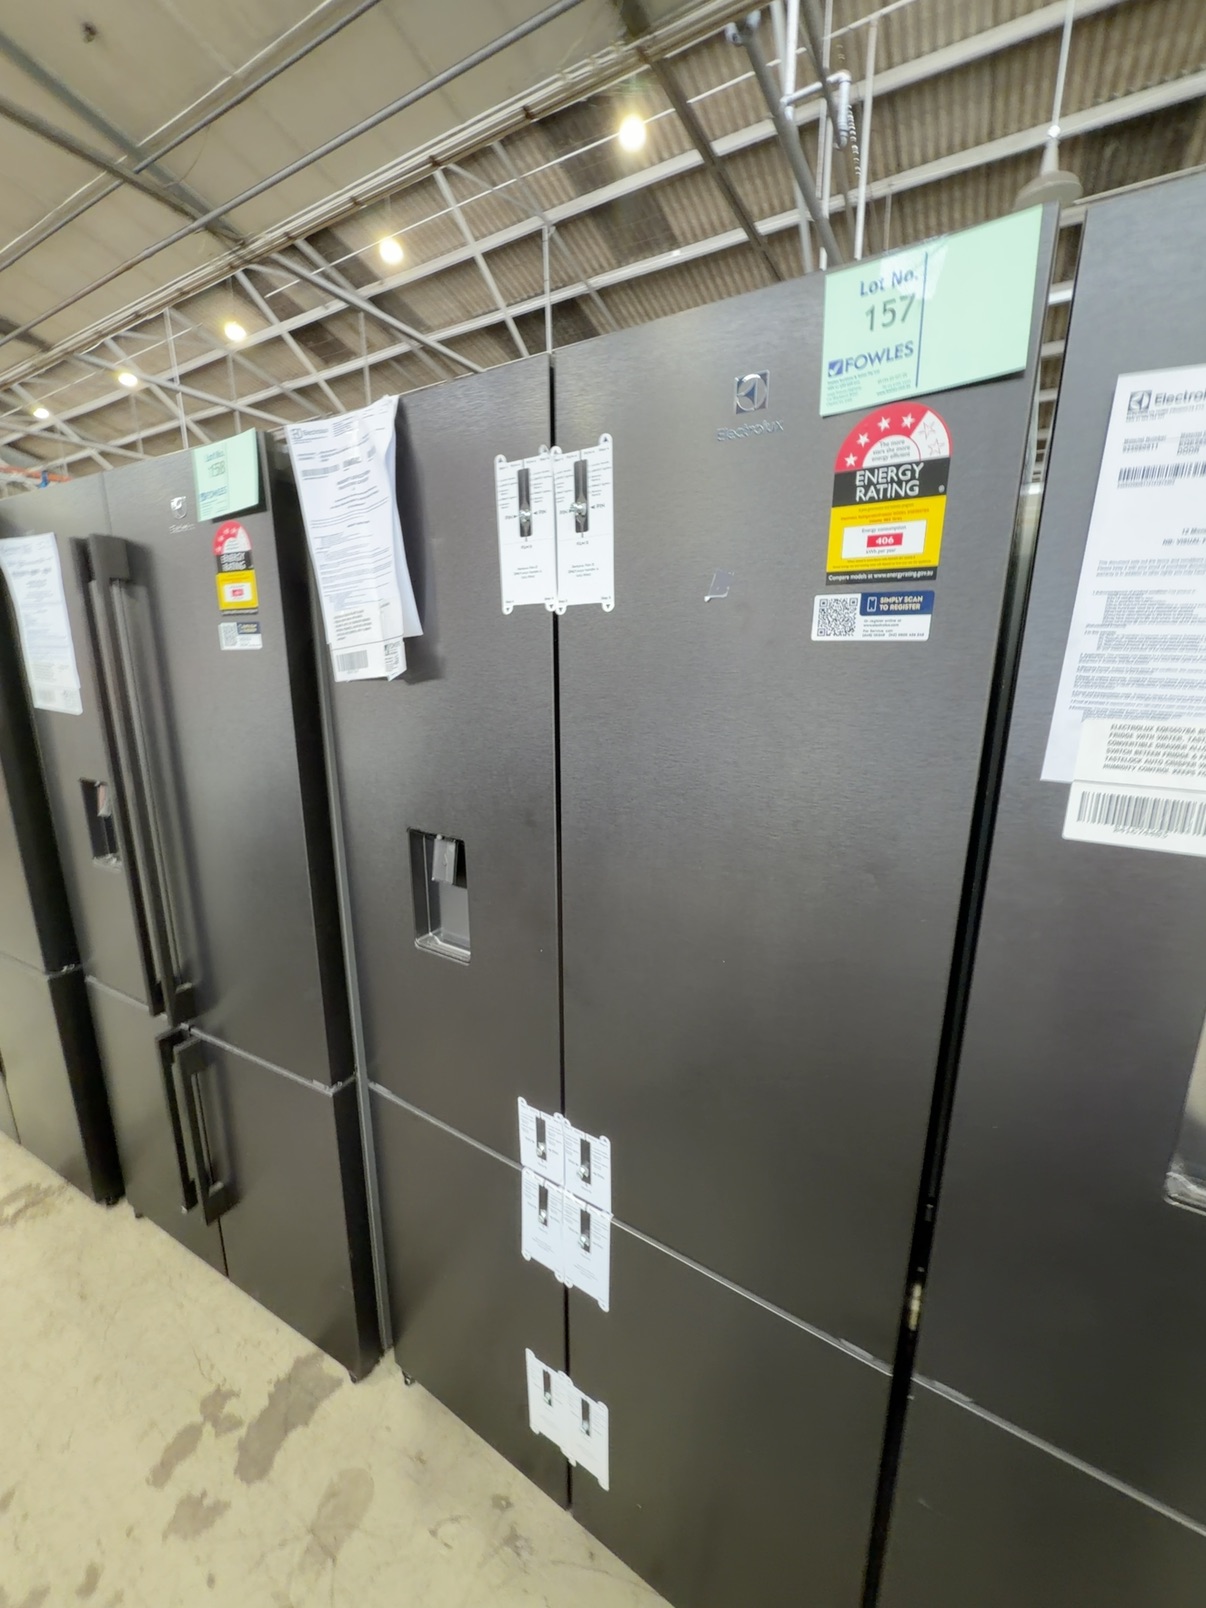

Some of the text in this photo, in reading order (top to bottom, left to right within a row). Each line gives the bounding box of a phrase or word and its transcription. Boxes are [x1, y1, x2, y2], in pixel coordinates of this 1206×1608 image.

[860, 269, 918, 297] Lot No.
[865, 293, 915, 332] 157
[845, 340, 914, 373] FOWLES
[715, 419, 784, 441] Electrolux
[890, 439, 905, 447] more
[890, 452, 910, 460] efficient
[855, 462, 924, 487] ENERGY
[856, 480, 920, 502] RATING
[877, 525, 906, 533] consumption
[876, 536, 894, 545] 406
[880, 595, 923, 604] SIMPLY SCAN
[890, 603, 920, 611] REGISTER
[1110, 724, 1154, 732] ELECTROLUX
[1107, 740, 1153, 748] CONVERTIBLE
[1155, 742, 1188, 750] DRAWER
[1161, 751, 1189, 759] FRIDGE
[1103, 763, 1137, 771] HUMIDITY
[1165, 760, 1197, 768] CRISPER
